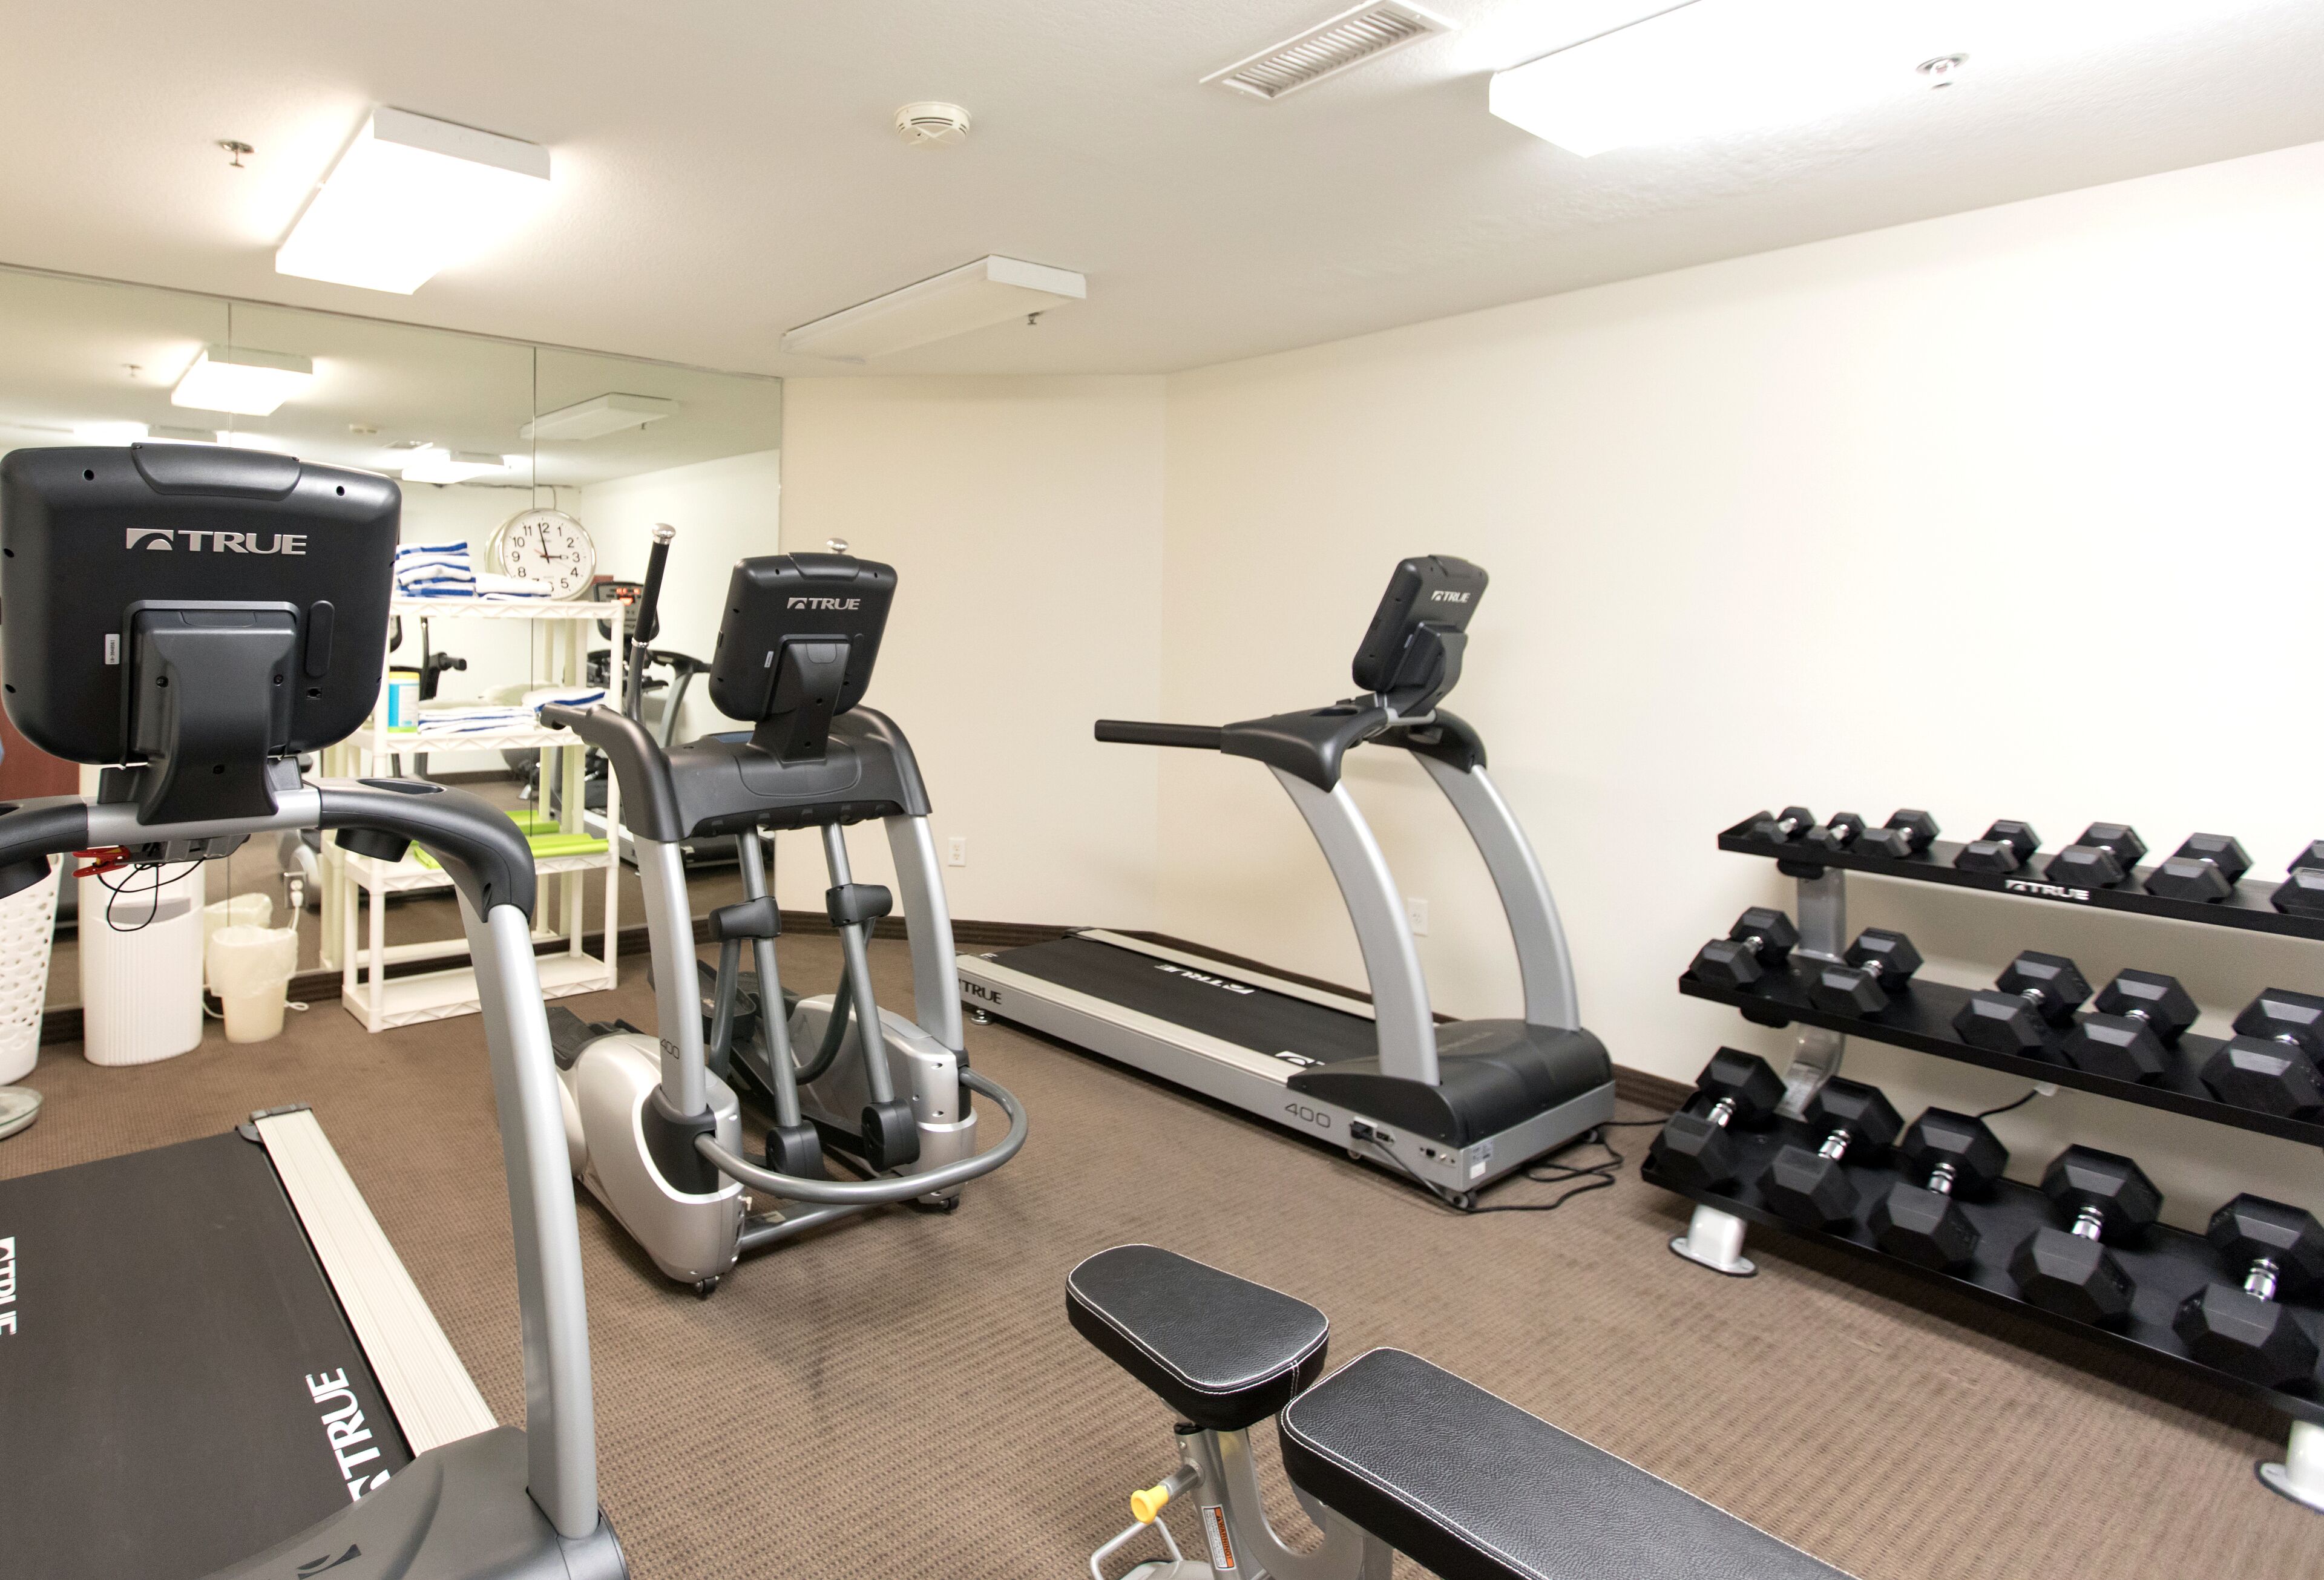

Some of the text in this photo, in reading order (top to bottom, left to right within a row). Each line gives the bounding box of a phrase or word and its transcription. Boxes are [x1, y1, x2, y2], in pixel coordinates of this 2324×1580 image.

[523, 525, 532, 536] 11
[557, 526, 562, 537] 1
[178, 530, 307, 555] TRUE
[513, 536, 525, 548] 10
[566, 537, 574, 548] 2
[511, 551, 520, 562] 9
[572, 551, 580, 563] 3
[517, 566, 527, 578] 8
[570, 567, 579, 578] 4
[560, 578, 569, 589] 5
[1443, 591, 1471, 603] TRUE
[809, 598, 861, 610] TRUE
[2025, 882, 2090, 900] TRUE
[962, 980, 1002, 1005] TRUE
[660, 1038, 680, 1059] 400
[1285, 1103, 1331, 1128] 400
[305, 1368, 381, 1480] TRUE
